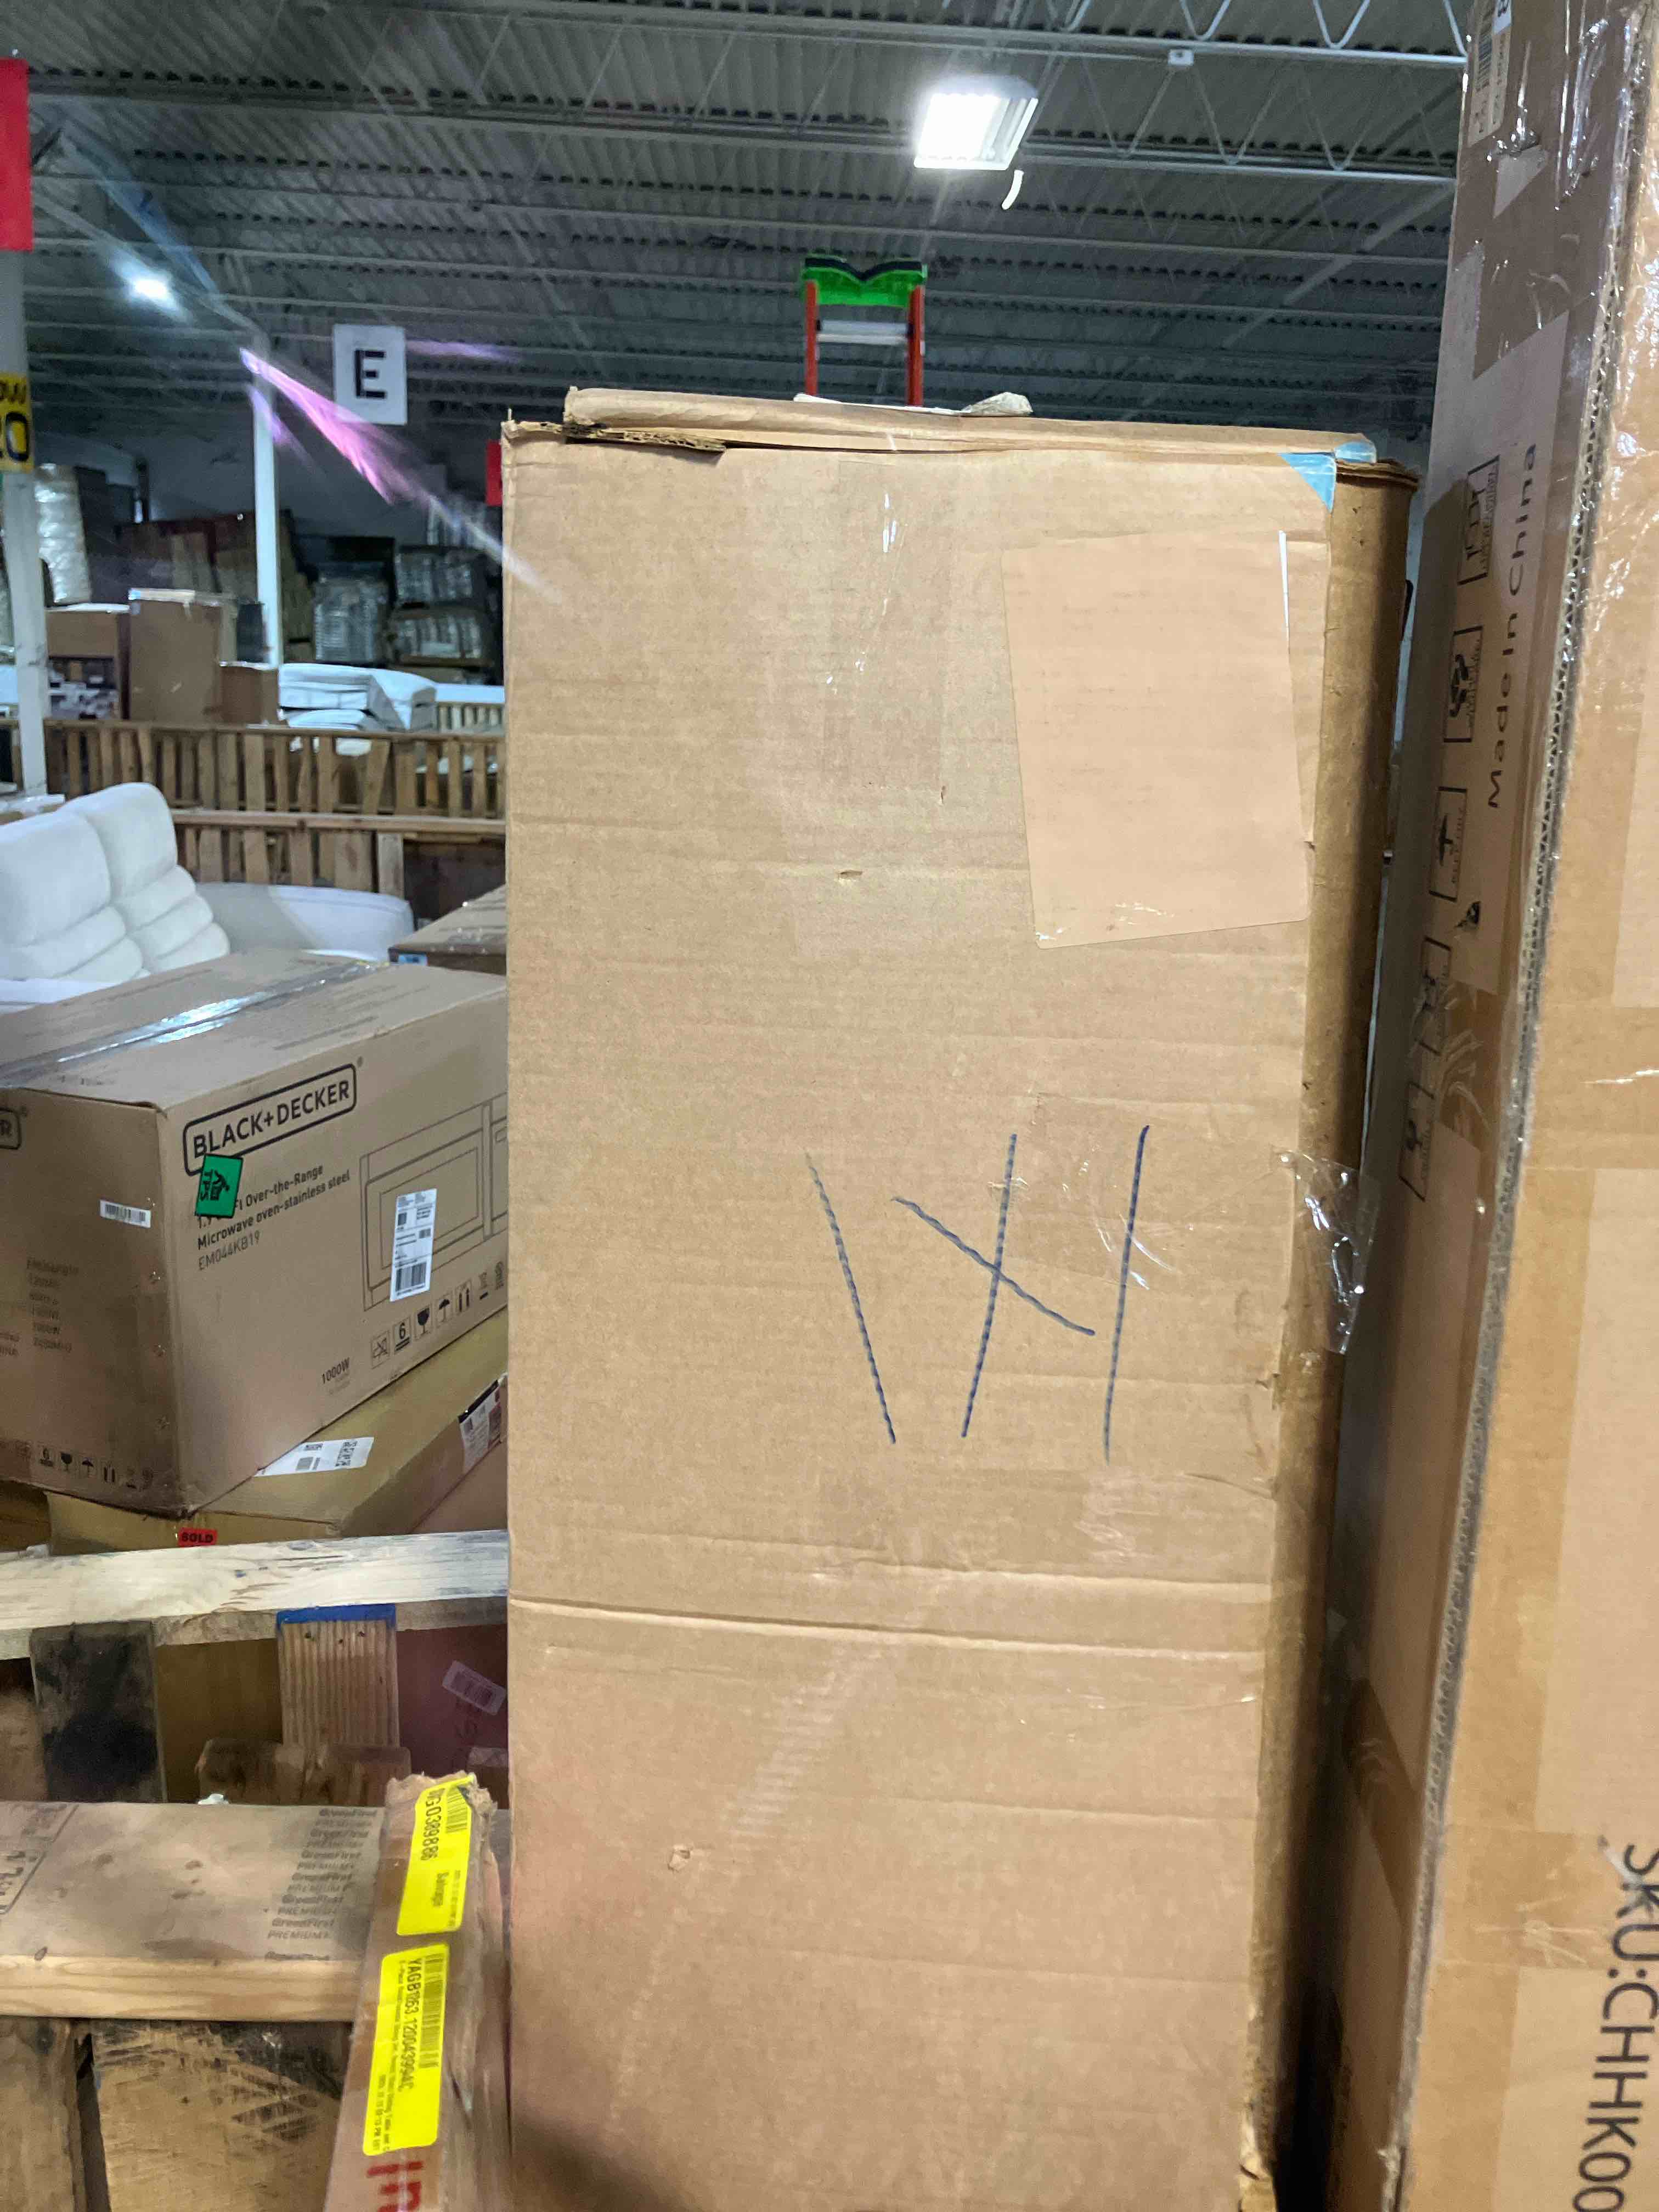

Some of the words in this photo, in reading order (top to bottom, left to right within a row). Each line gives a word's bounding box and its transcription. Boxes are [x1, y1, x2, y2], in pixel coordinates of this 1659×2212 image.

[354, 349, 387, 400] E
[193, 1080, 351, 1159] BLACK+DECKER
[245, 1165, 324, 1207] Over-the-Range
[197, 1216, 254, 1250] Microwave
[256, 1182, 326, 1223] oven-stainless
[328, 1169, 351, 1189] steel
[399, 1322, 406, 1340] 6
[321, 1357, 350, 1384] 1000W
[181, 1532, 213, 1543] SOLD
[1572, 1843, 1659, 2212] SKU:CHHK00
